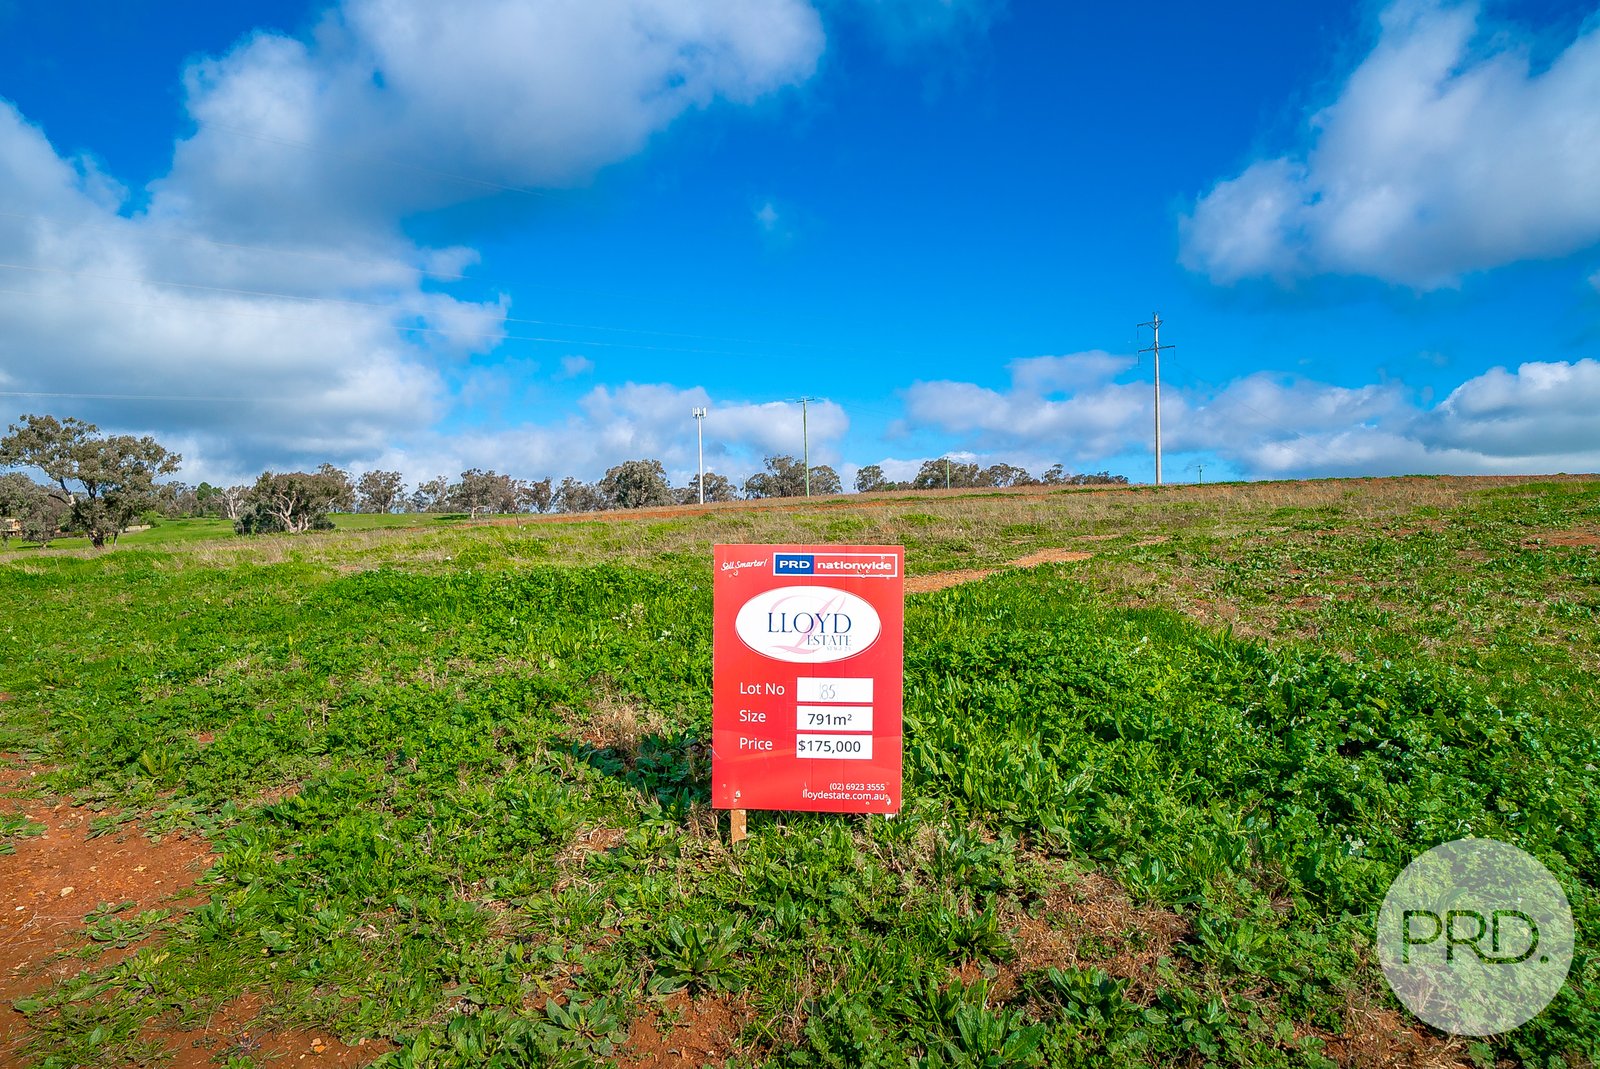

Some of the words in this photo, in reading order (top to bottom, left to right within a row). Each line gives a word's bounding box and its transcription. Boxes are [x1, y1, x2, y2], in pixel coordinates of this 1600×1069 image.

[779, 560, 811, 569] PRD
[817, 560, 892, 571] nationwide
[767, 612, 852, 634] LLOYD
[807, 634, 852, 646] ESTATE
[740, 682, 761, 695] Lot
[765, 683, 785, 696] No
[739, 709, 767, 723] Size
[807, 713, 853, 726] 791m²
[739, 737, 773, 751] Price
[798, 740, 861, 754] $175,000
[829, 783, 844, 791] (02)
[845, 783, 865, 791] 6923
[866, 783, 885, 791] 3555
[802, 788, 885, 801] lloydestate.com.au
